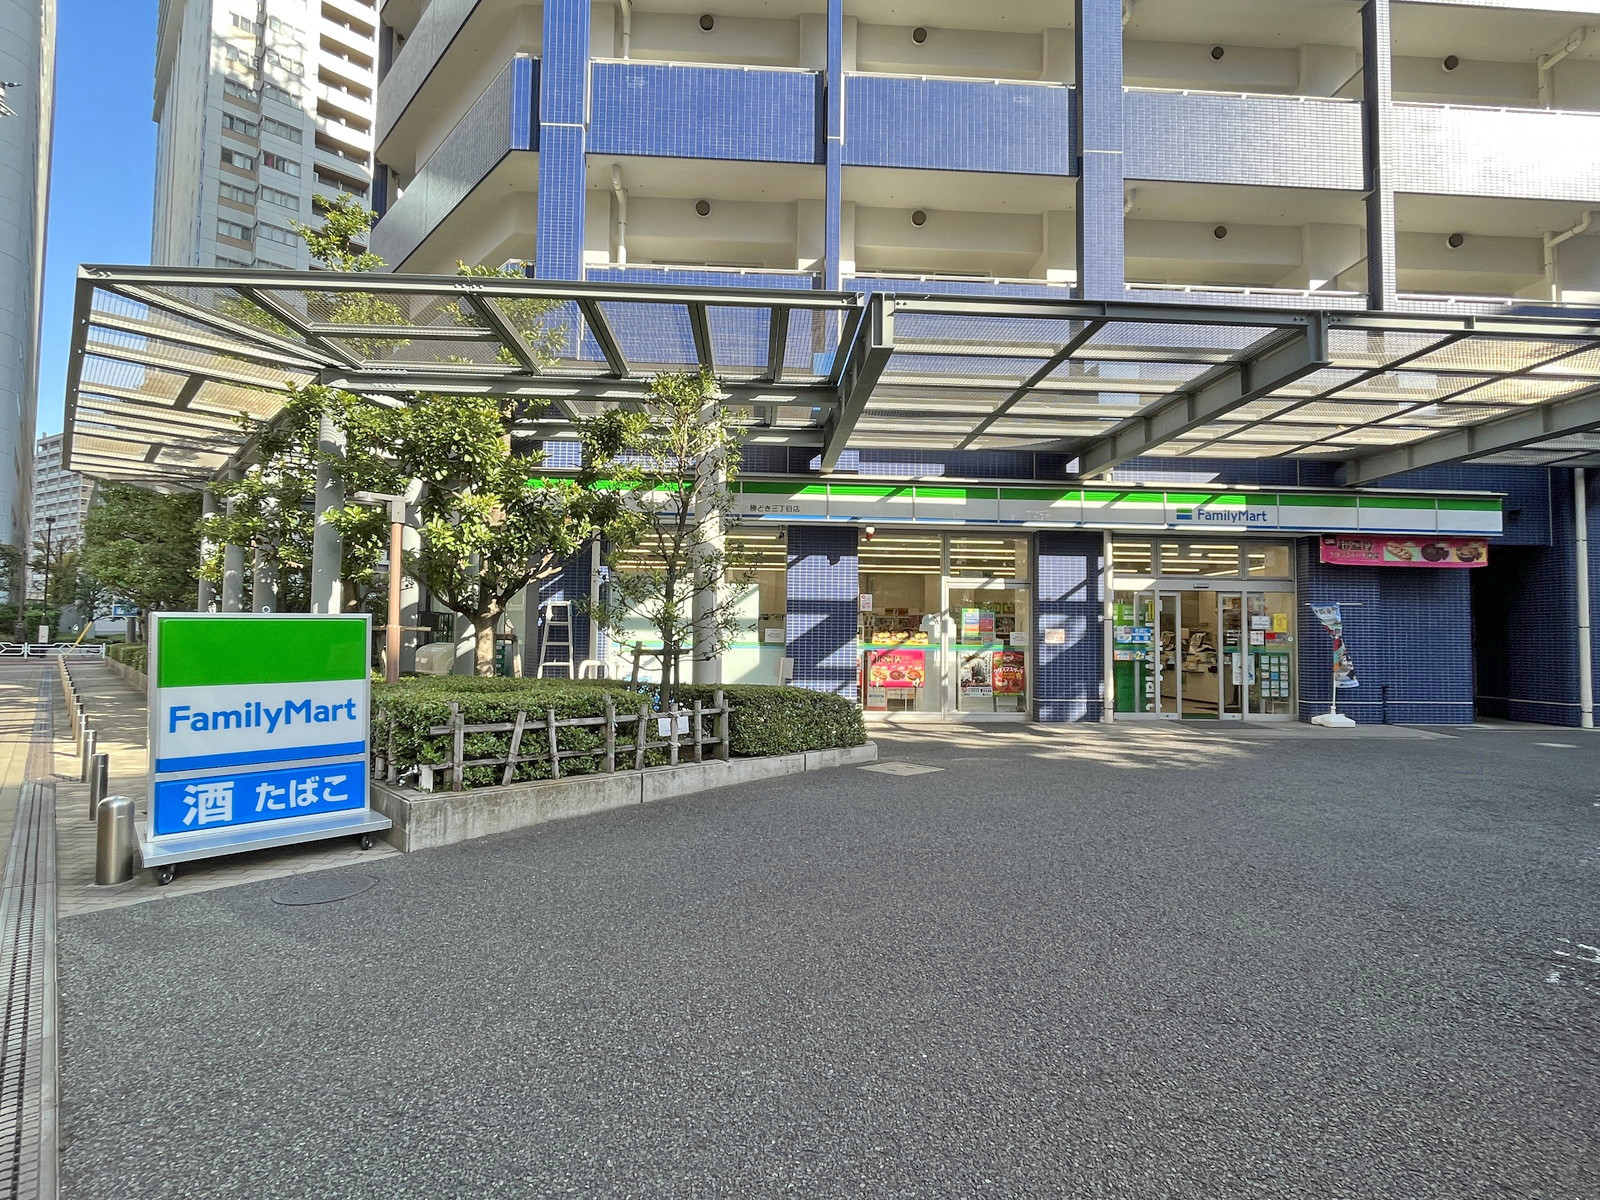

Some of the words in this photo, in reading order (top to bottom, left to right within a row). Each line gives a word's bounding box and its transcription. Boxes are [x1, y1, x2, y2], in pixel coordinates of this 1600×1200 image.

[749, 504, 800, 513] 勝どき三丁目店
[1197, 508, 1267, 523] FamilyMart
[168, 697, 356, 734] FamilyMart
[182, 781, 235, 826] 酒
[254, 775, 349, 812] たばこ
